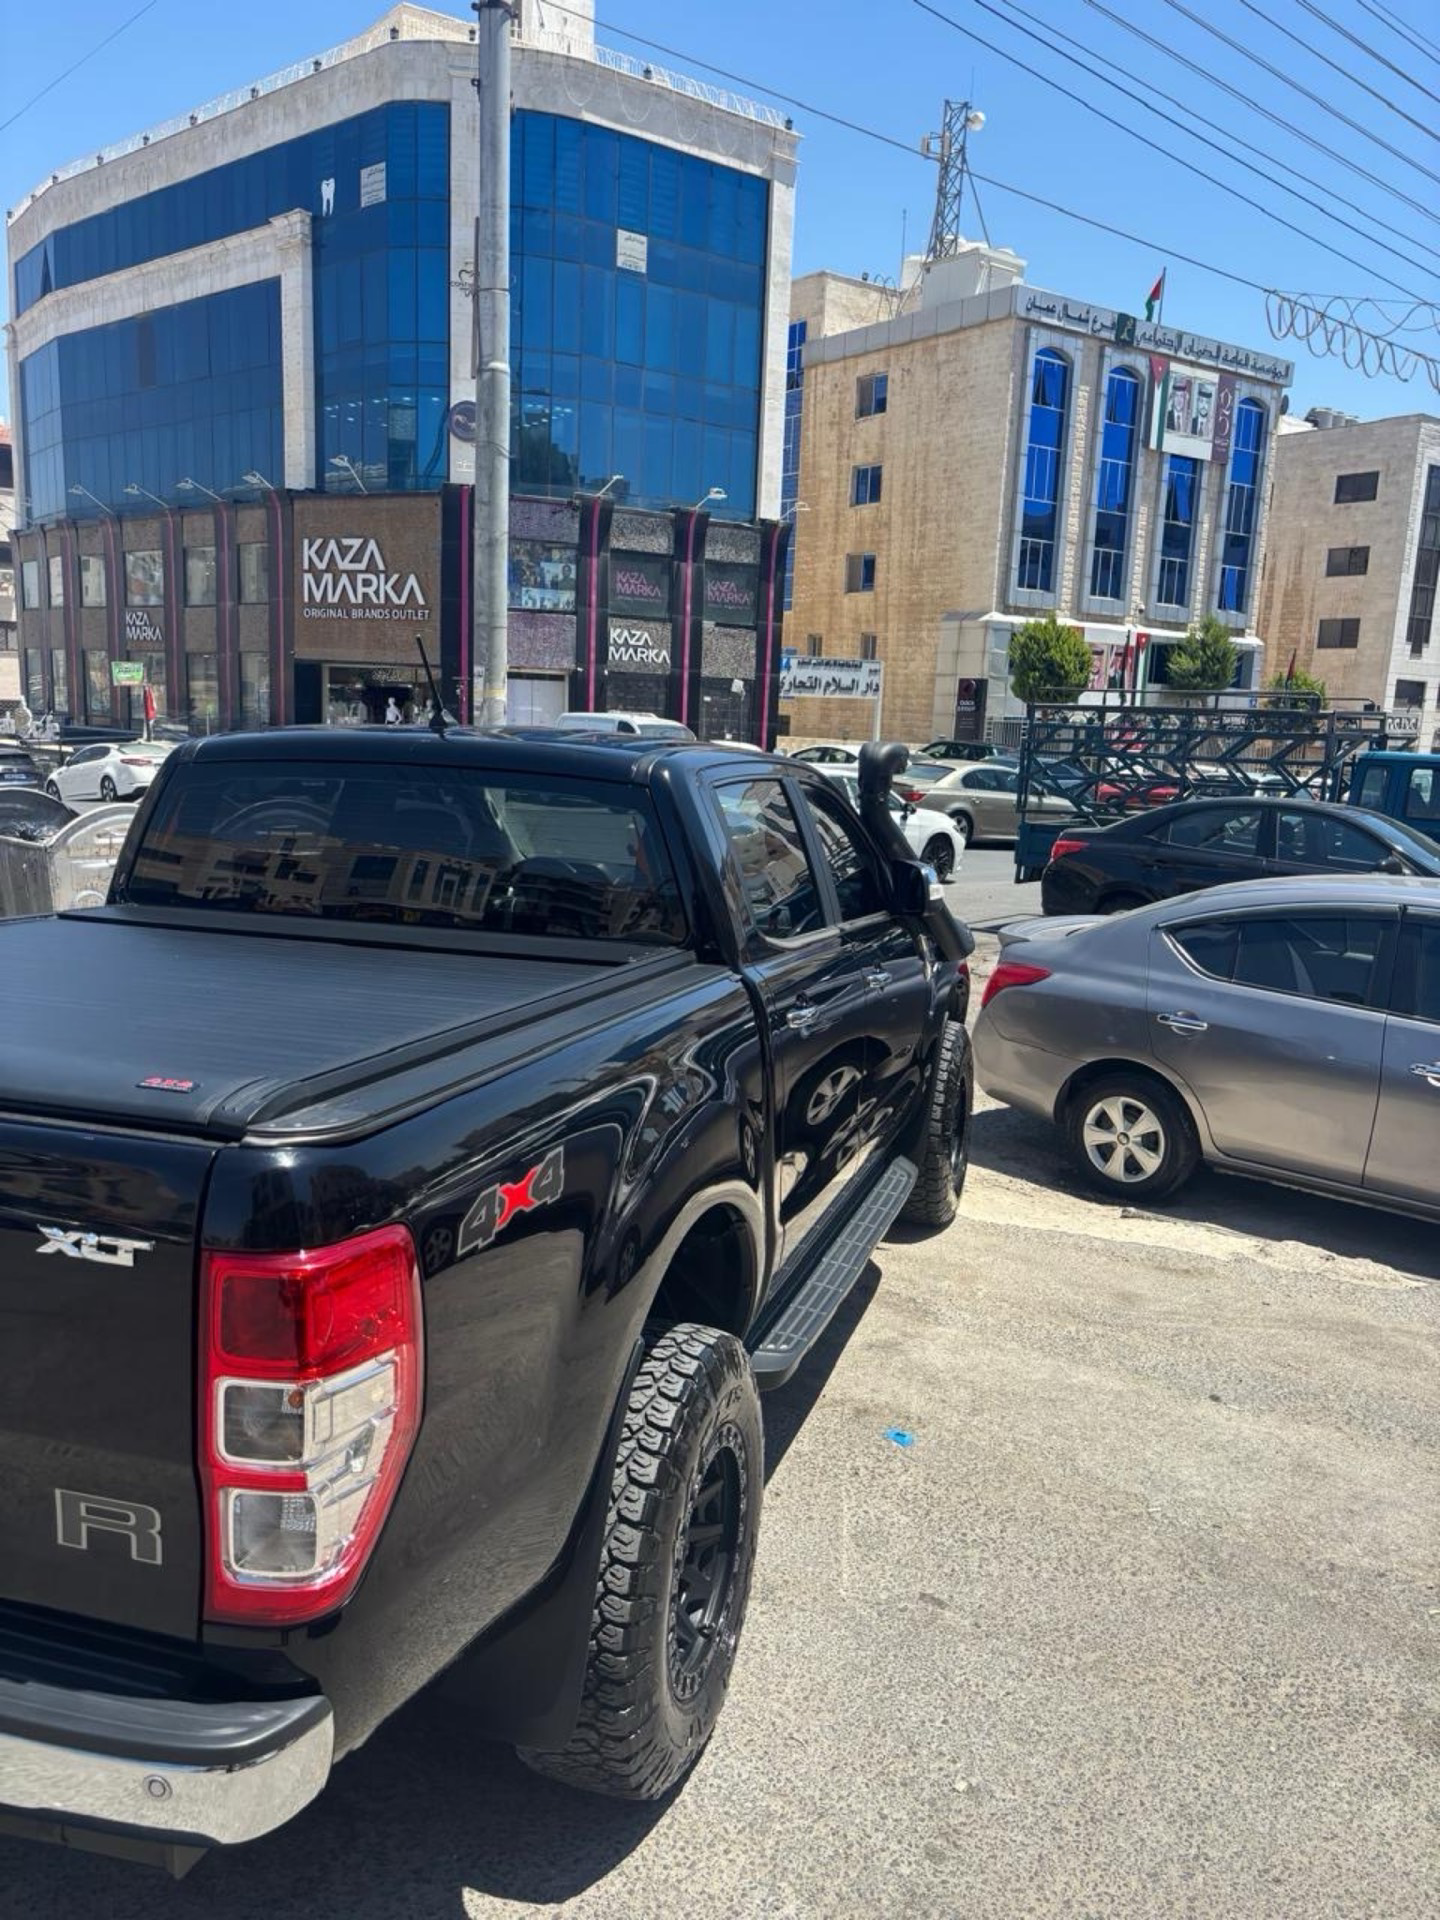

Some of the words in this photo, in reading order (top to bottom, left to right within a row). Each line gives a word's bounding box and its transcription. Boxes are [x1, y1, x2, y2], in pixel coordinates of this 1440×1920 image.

[1025, 295, 1057, 313] عمان
[1057, 302, 1091, 324] شمال
[302, 537, 386, 571] KAZA
[616, 570, 647, 584] KAZA
[303, 572, 426, 606] MARKA
[616, 583, 661, 598] MARKA
[126, 611, 150, 626] KAZA
[303, 607, 349, 619] ORIGINAL
[351, 608, 391, 619] BRANDS
[391, 609, 430, 621] OUTLET
[126, 625, 163, 641] MARKA
[609, 627, 652, 646] KAZA
[608, 645, 671, 664] MARKA
[823, 676, 860, 696] السلام
[862, 679, 880, 694] دار
[35, 1223, 156, 1267] XLT
